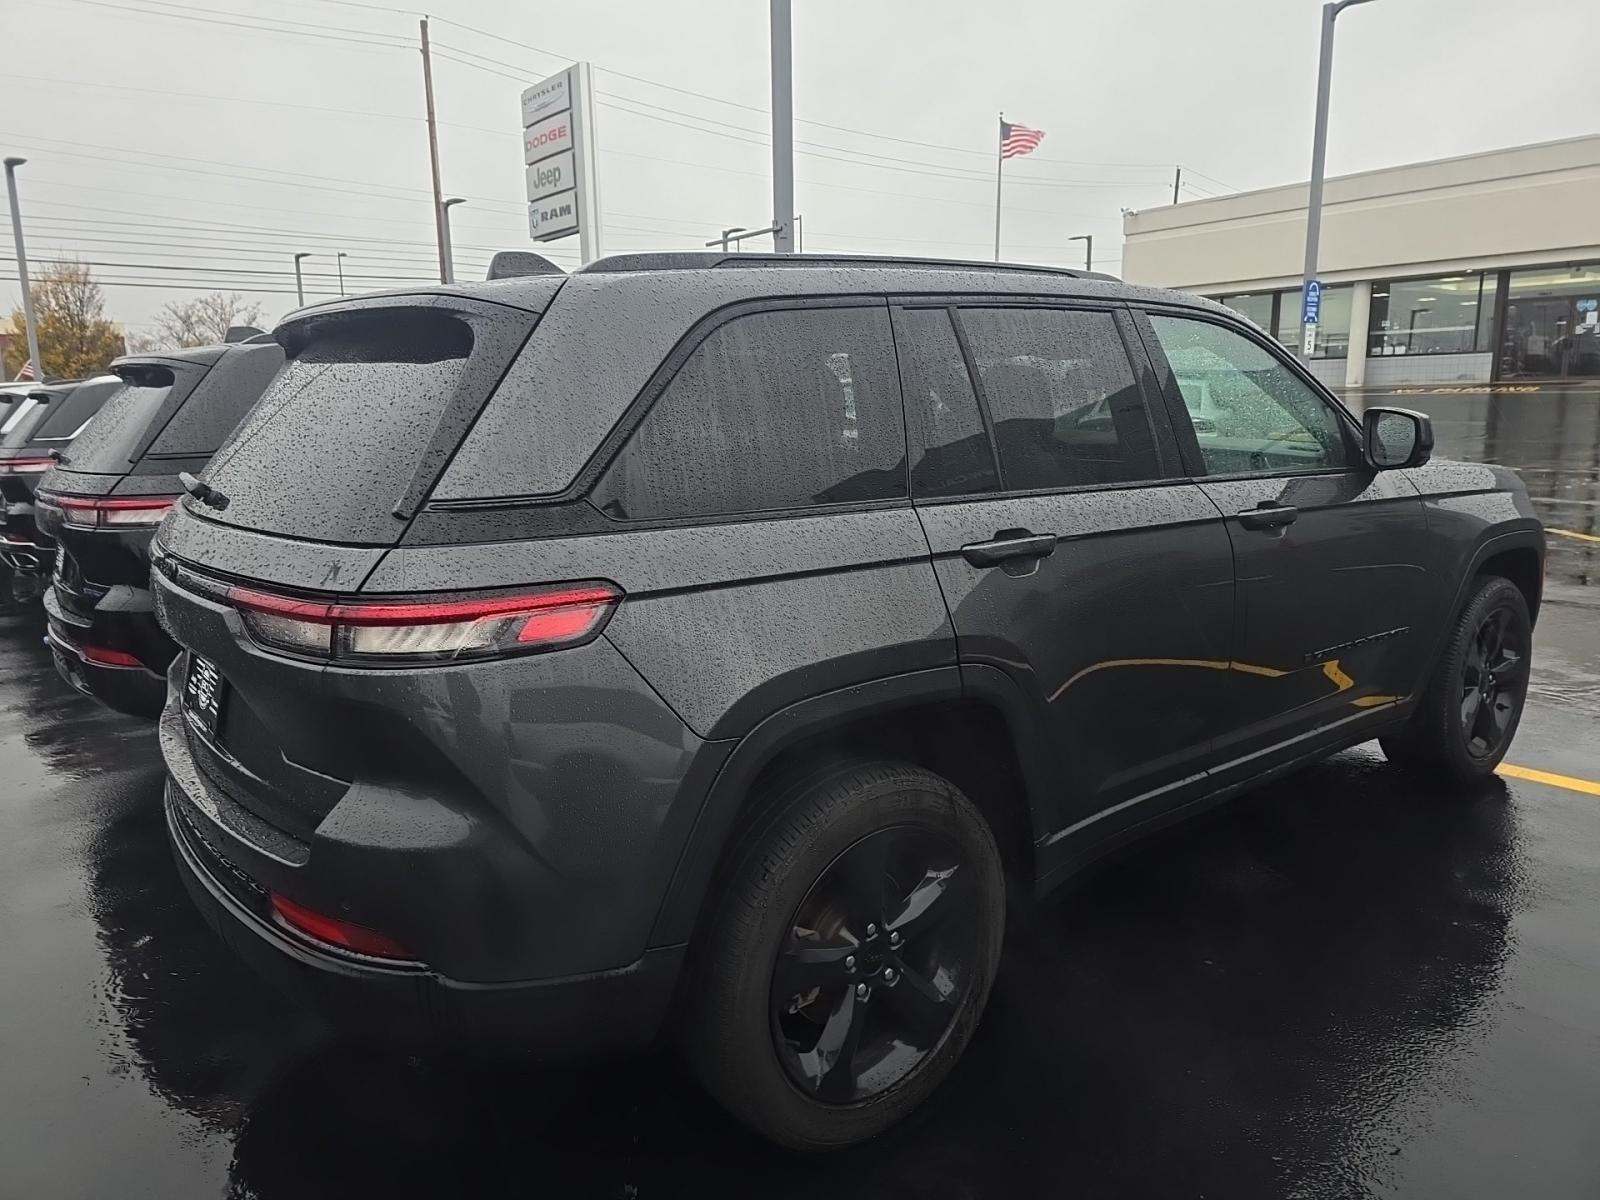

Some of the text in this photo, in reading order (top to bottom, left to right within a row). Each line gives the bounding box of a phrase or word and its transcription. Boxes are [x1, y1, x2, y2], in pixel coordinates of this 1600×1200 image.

[523, 82, 562, 106] CHRYSLER
[526, 126, 567, 152] DODGE
[533, 166, 561, 188] Jeep
[541, 204, 571, 222] RAM
[1307, 340, 1312, 351] 5
